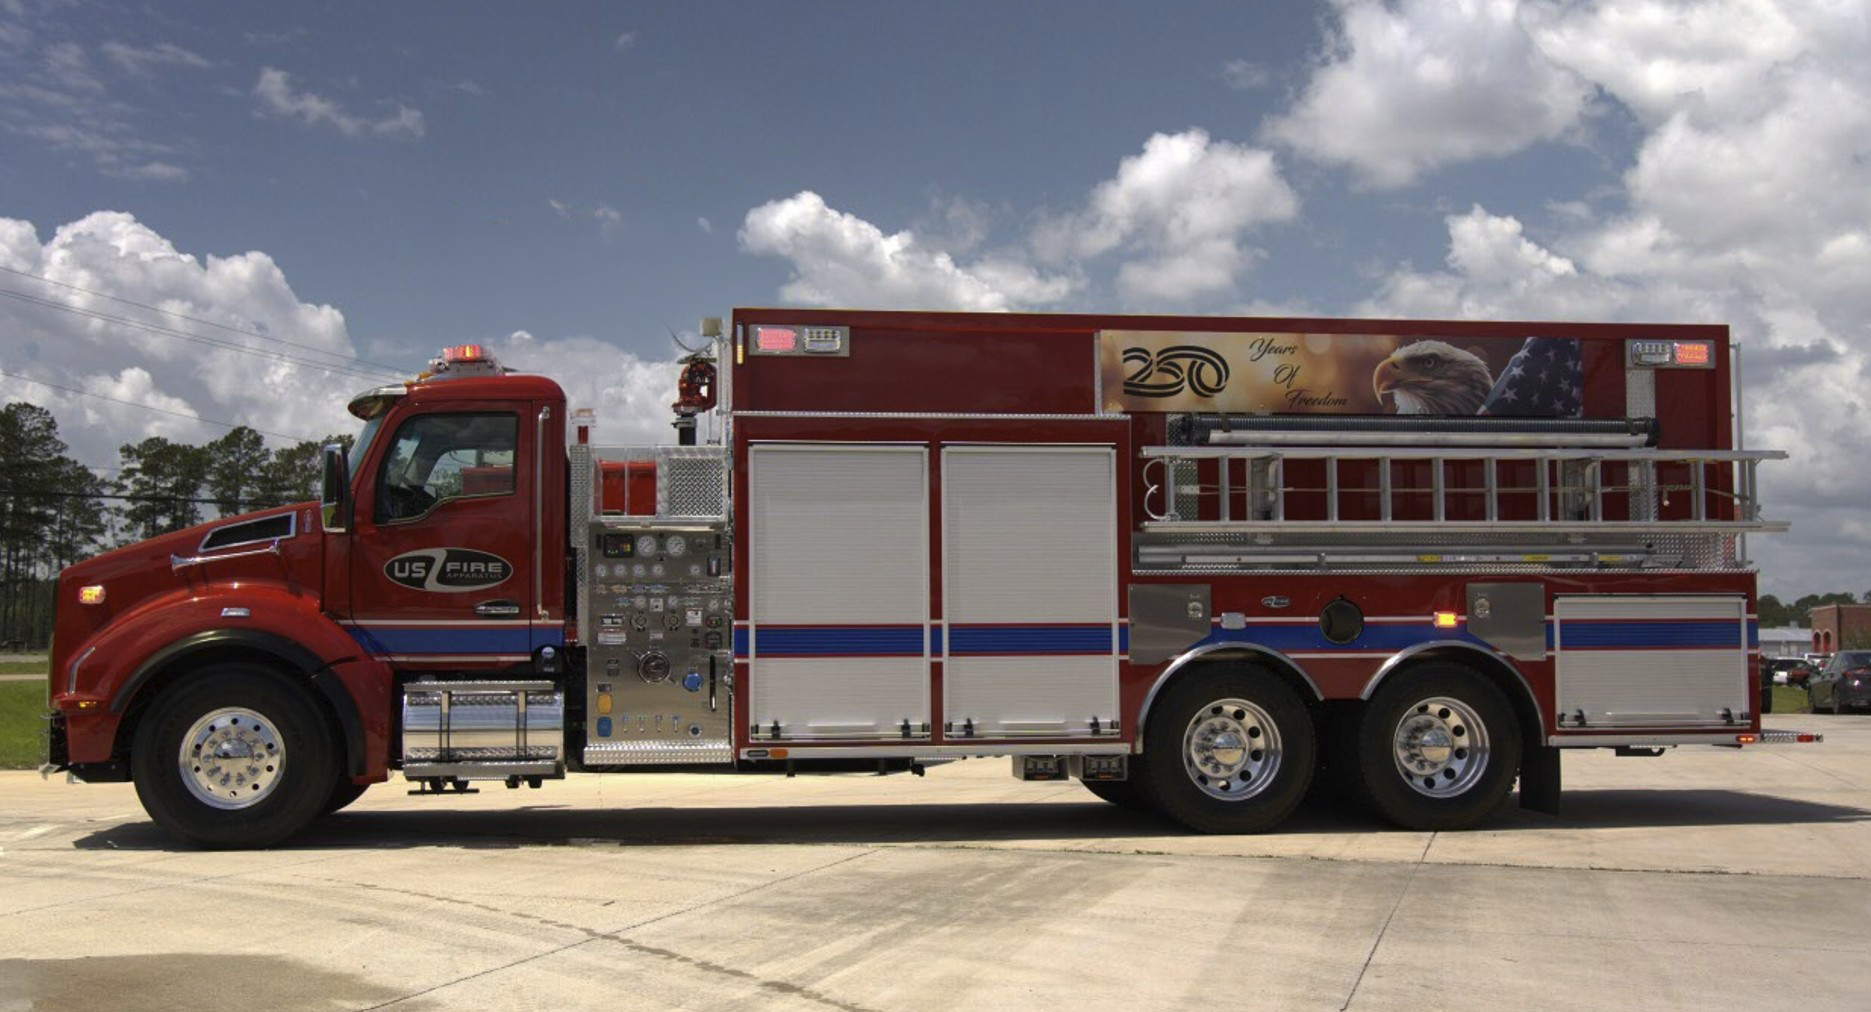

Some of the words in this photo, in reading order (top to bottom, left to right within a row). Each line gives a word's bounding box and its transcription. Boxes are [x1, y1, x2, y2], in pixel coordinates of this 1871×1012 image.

[1249, 338, 1297, 361] Years
[1123, 345, 1230, 398] 250
[1273, 364, 1301, 389] Of
[1285, 389, 1348, 408] Freedom
[394, 562, 426, 578] US
[446, 562, 503, 572] FIRE
